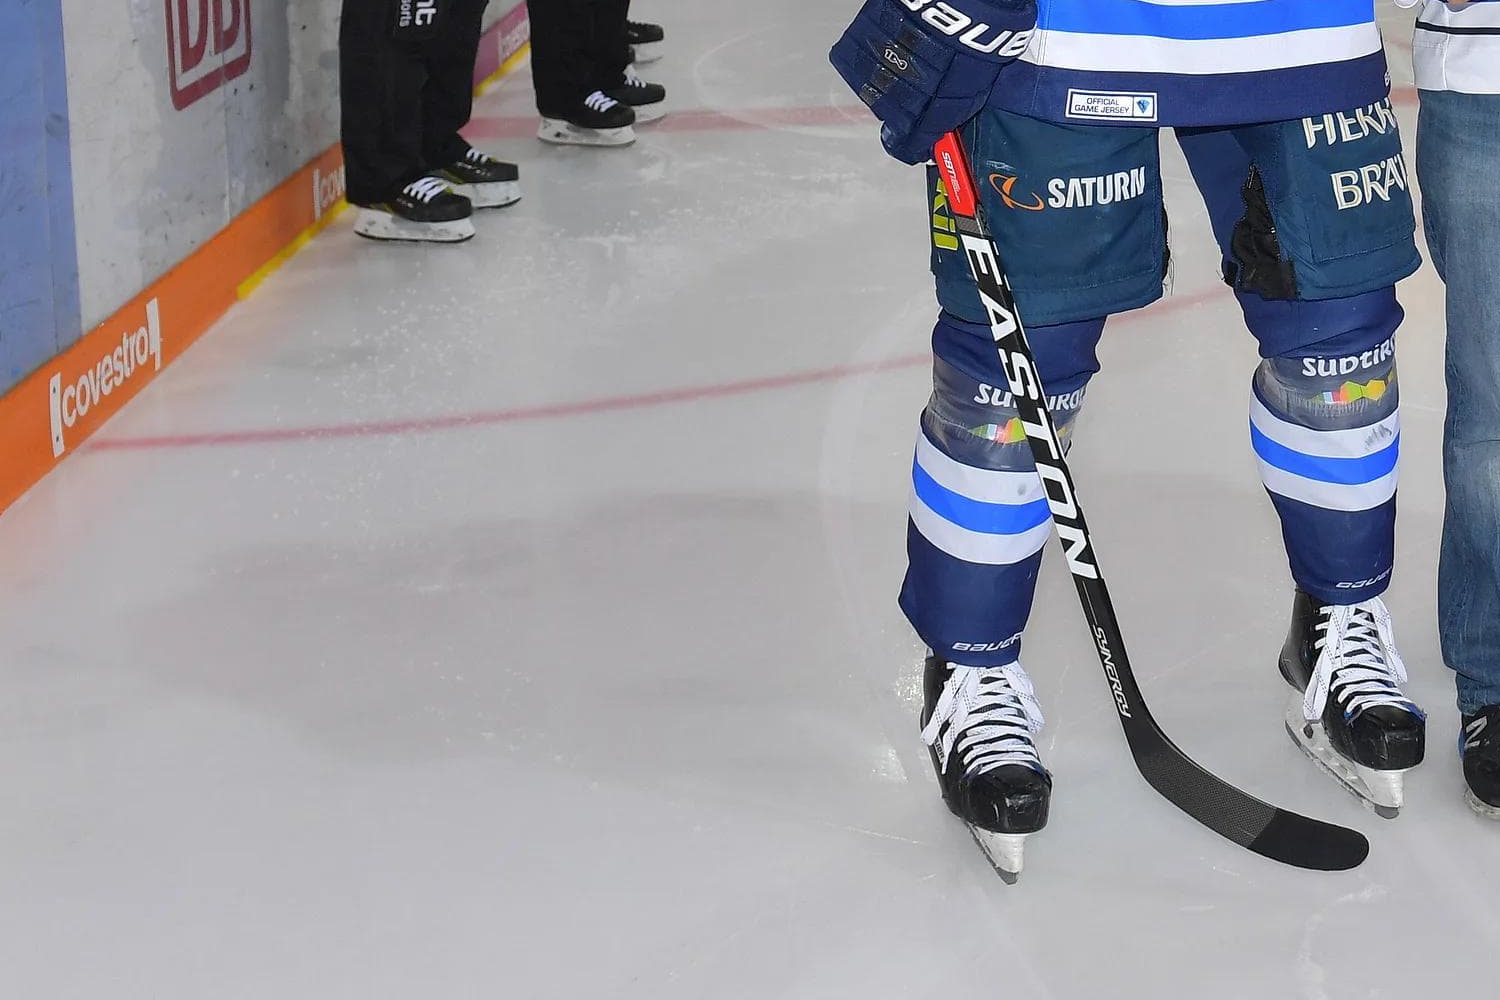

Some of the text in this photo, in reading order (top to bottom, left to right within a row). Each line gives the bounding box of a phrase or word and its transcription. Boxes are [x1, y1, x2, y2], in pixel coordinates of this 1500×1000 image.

[1074, 104, 1130, 114] GAME JERSEY
[1086, 97, 1120, 106] OFFICIAL
[1047, 165, 1146, 210] SATURN
[959, 233, 1099, 580] EASTON
[1092, 624, 1133, 719] SYNERGY
